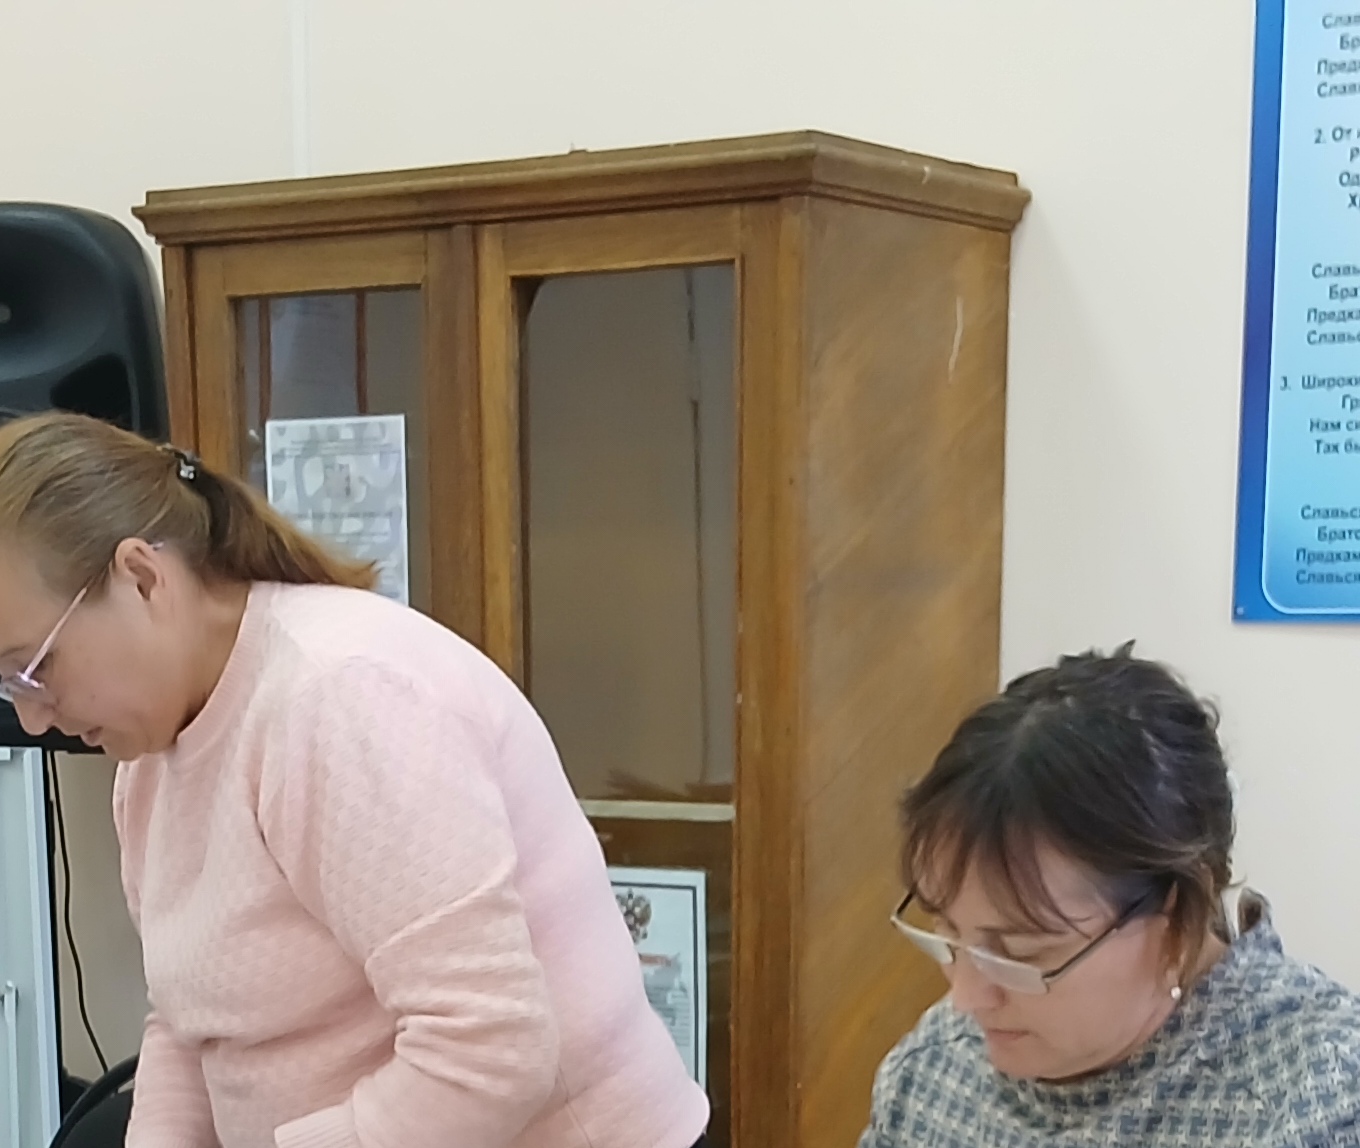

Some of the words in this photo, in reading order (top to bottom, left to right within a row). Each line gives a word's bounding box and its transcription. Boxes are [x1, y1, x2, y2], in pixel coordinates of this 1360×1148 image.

[1331, 126, 1353, 143] От
[1309, 418, 1342, 433] Нам
[1315, 439, 1340, 455] Так
